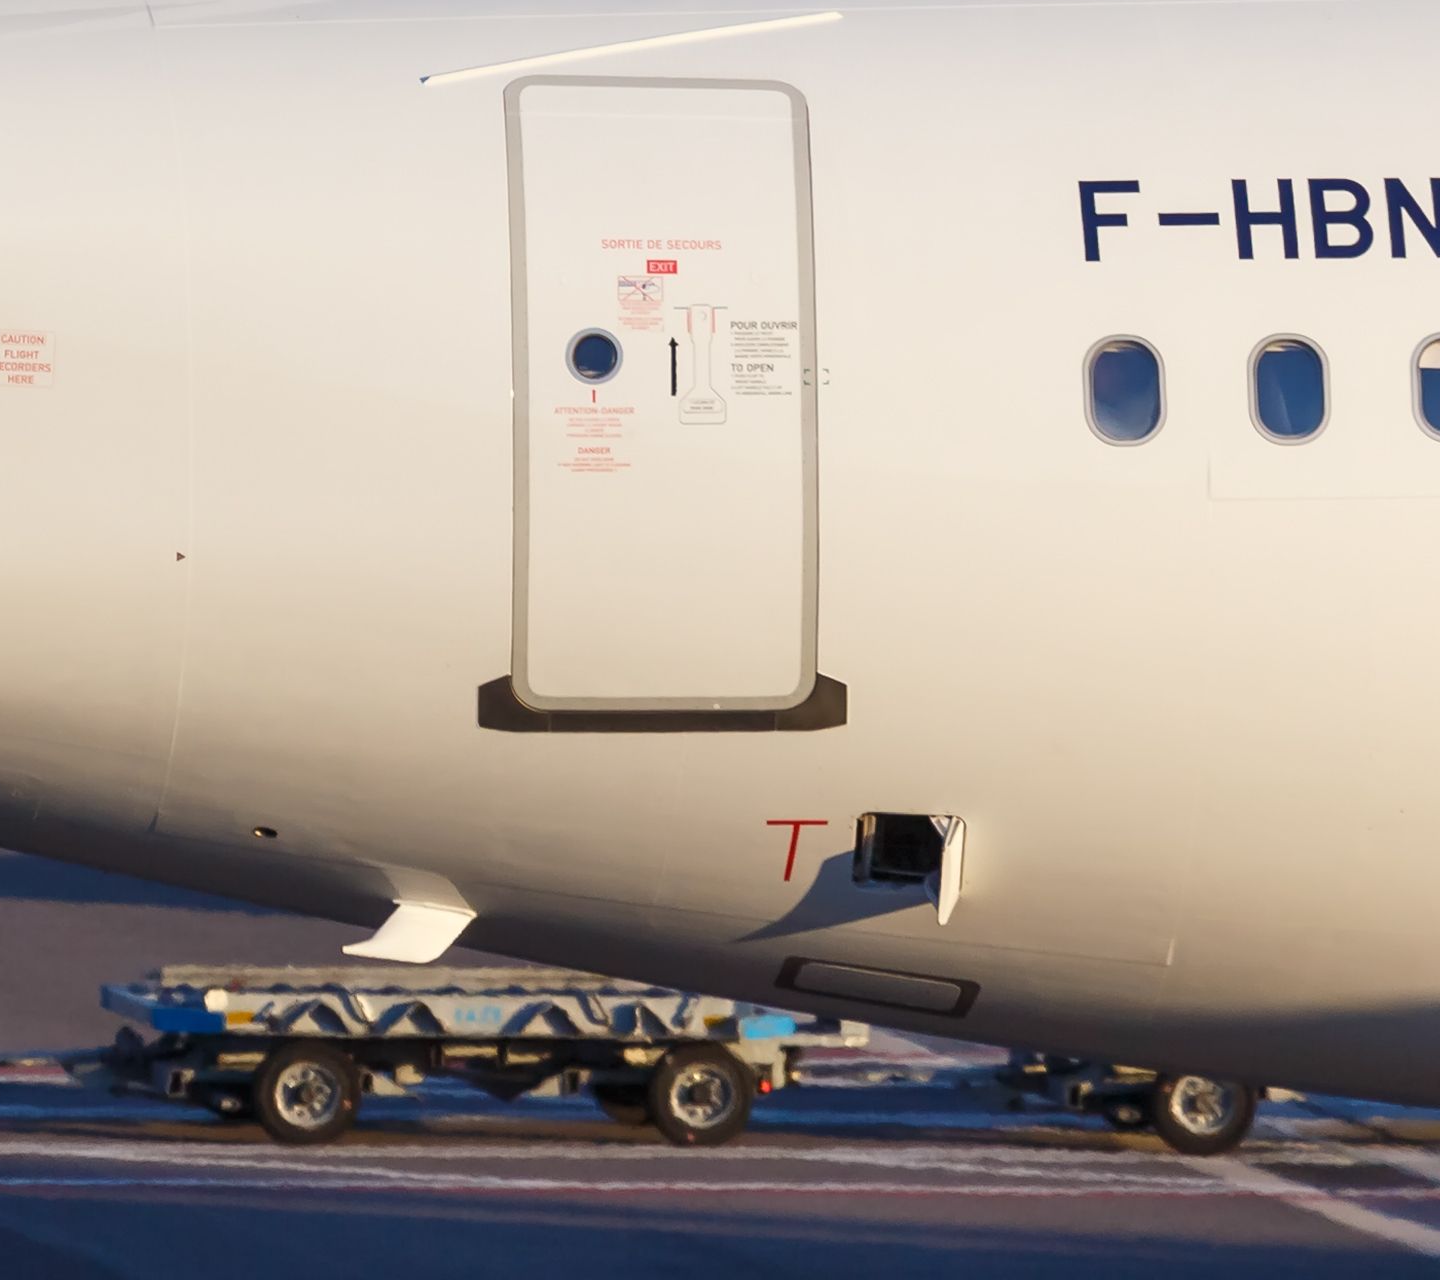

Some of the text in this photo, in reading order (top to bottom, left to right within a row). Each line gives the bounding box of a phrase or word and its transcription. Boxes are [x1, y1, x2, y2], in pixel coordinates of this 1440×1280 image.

[601, 239, 722, 250] SORTIE DE SECOURS
[648, 261, 676, 273] EXIT
[730, 321, 798, 330] POUR OUVRIR
[0, 334, 45, 344] CAUTION
[4, 350, 39, 360] FLIGHT
[731, 363, 774, 372] TO OPEN
[7, 374, 34, 384] HERE
